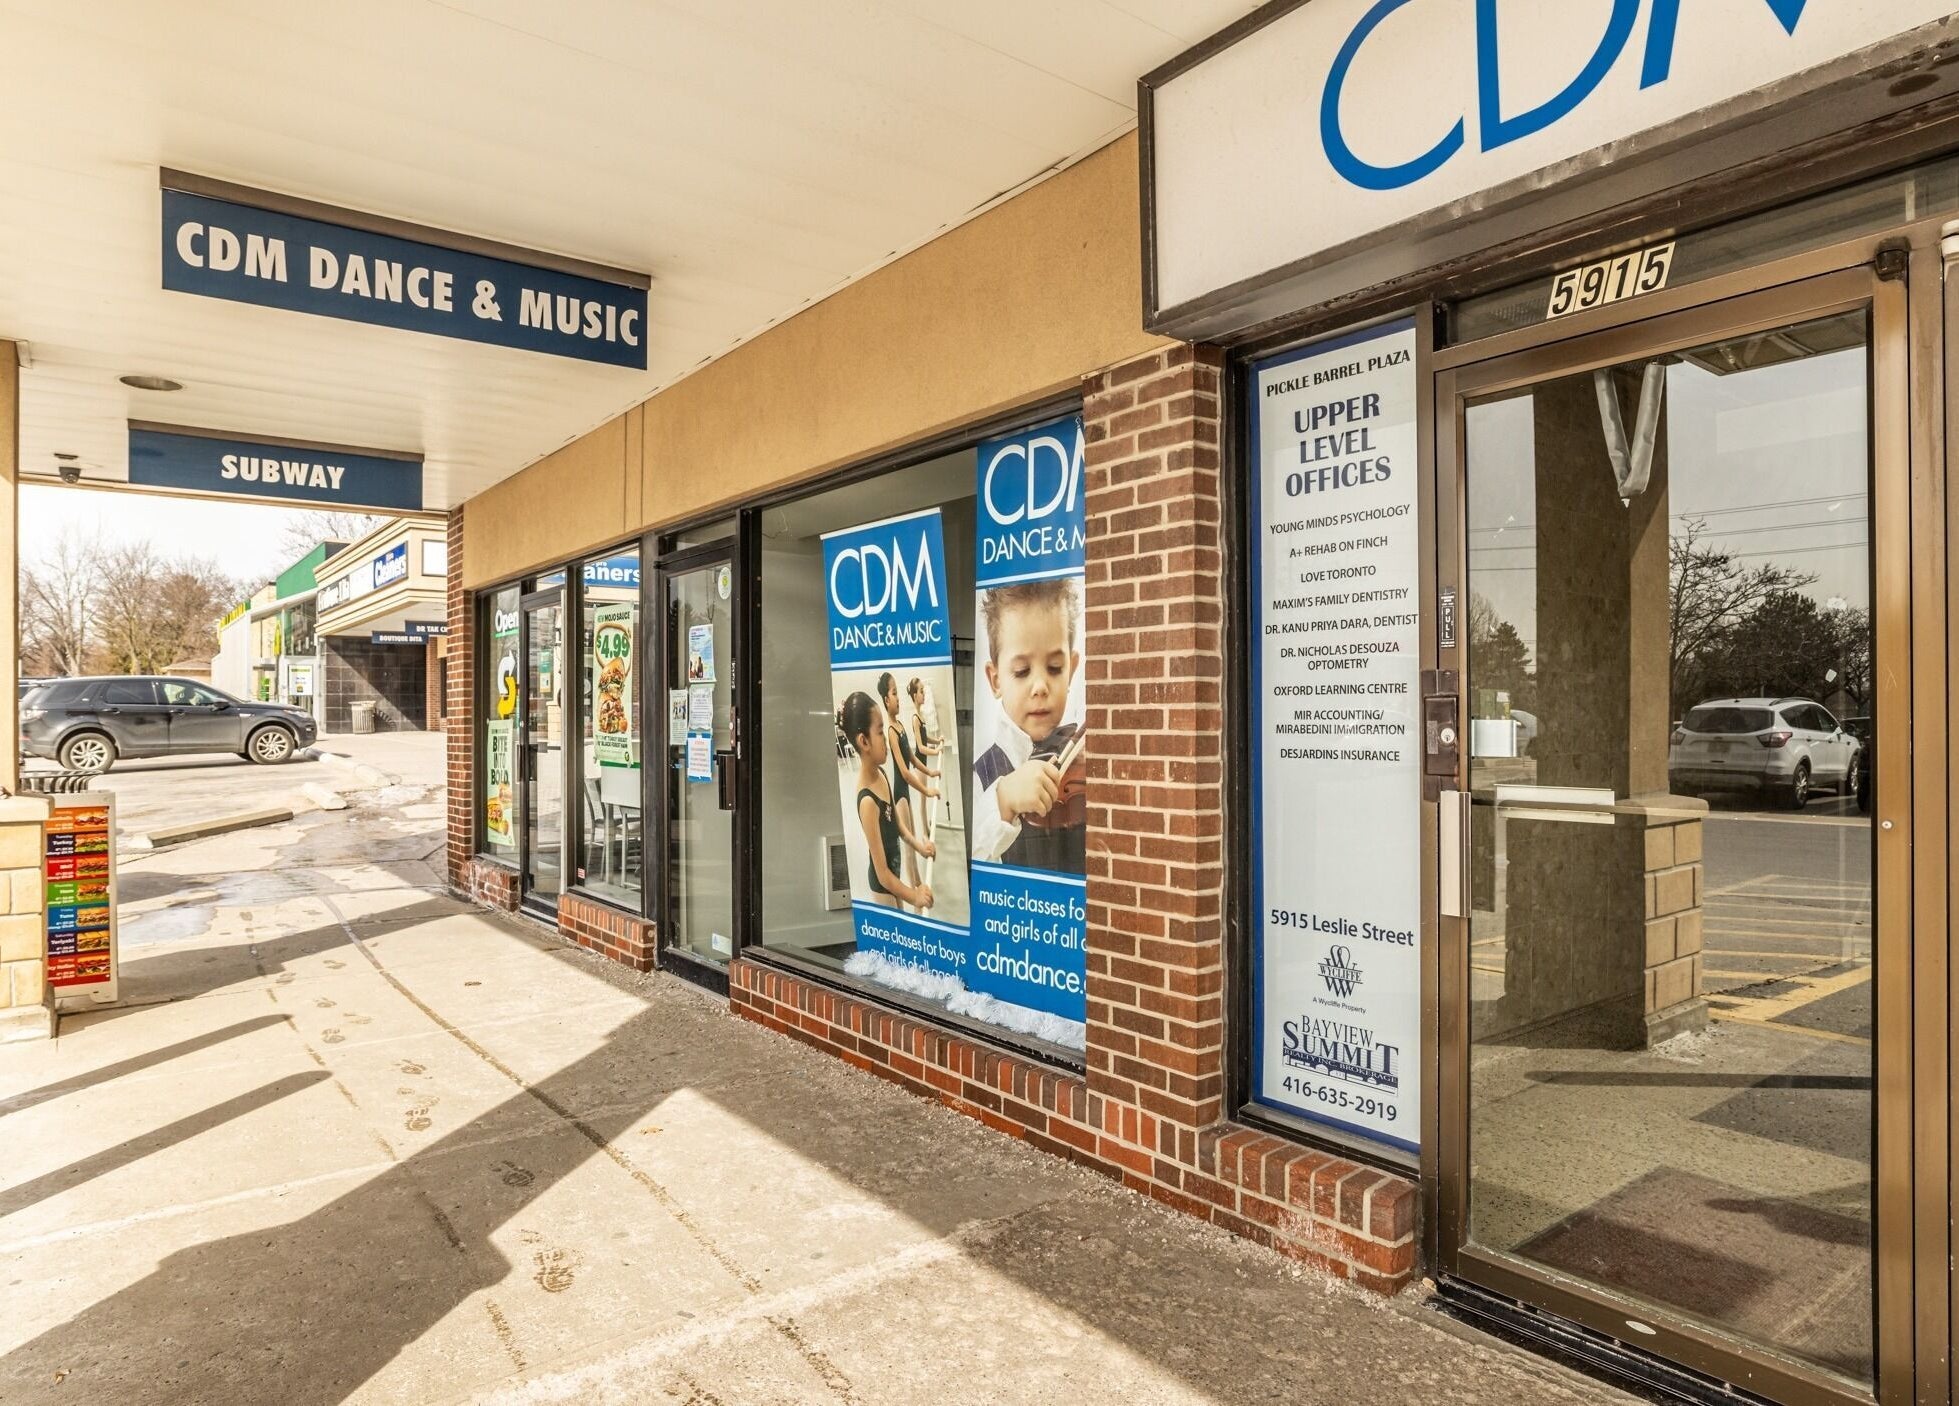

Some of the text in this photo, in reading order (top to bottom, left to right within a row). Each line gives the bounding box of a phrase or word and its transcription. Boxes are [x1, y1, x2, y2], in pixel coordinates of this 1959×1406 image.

[1320, 0, 1803, 190] CD
[176, 222, 639, 346] CDM DANCE & MUSIC
[1551, 246, 1673, 315] 5915
[1266, 349, 1411, 397] PICKLE BARREL PLAZA
[1294, 393, 1380, 434] UPPER
[1300, 427, 1377, 464] LEVEL
[221, 454, 346, 490] SUBWAY
[1286, 456, 1391, 497] OFFICES
[1270, 504, 1411, 535] YOUNG MINDS PSYCHOLOGY
[983, 527, 1052, 564] DANCE
[1055, 527, 1068, 553] &
[1289, 536, 1388, 558] A+ REHAB ON FINCH
[830, 530, 938, 618] CDM
[1300, 565, 1376, 583] LOVE TORONTO
[1273, 588, 1409, 610] MAXIM'S FAMILY DENTISTRY
[495, 609, 520, 632] Open
[834, 620, 941, 650] DANCE & MUSIC
[1265, 613, 1418, 635] DR. KANU PRIYA DARA, DENTIST
[596, 633, 631, 658] $4.99
[1281, 642, 1399, 658] DR. NICHOLAS DESOUZA
[1308, 658, 1369, 670] OPTOMETRY
[1274, 683, 1407, 696] OXFORD LEARNING CENTRE
[1276, 724, 1405, 735] MIRABEDINI IMMIGRATION
[1294, 710, 1384, 721] MIR ACCOUNTING/
[493, 735, 507, 752] BITE
[1280, 748, 1400, 761] DESJARDINS INSURANCE
[979, 889, 1015, 909] music
[1017, 890, 1066, 918] classes
[861, 919, 967, 967] dance classes for boys
[985, 915, 1010, 936] and
[1012, 920, 1040, 944] girls
[1043, 926, 1058, 946] of
[1061, 927, 1078, 949] all
[1271, 909, 1414, 946] 5915 Leslie Street
[977, 943, 1086, 994] cdmdance.
[1320, 965, 1362, 981] WYCLIFFE
[1283, 1021, 1399, 1075] SUMMIT
[1302, 1015, 1373, 1048] BAYVIEW
[1284, 1049, 1318, 1062] REALTY
[1340, 1063, 1398, 1083] BROKERAGE
[1282, 1076, 1397, 1122] 416-635-2919
